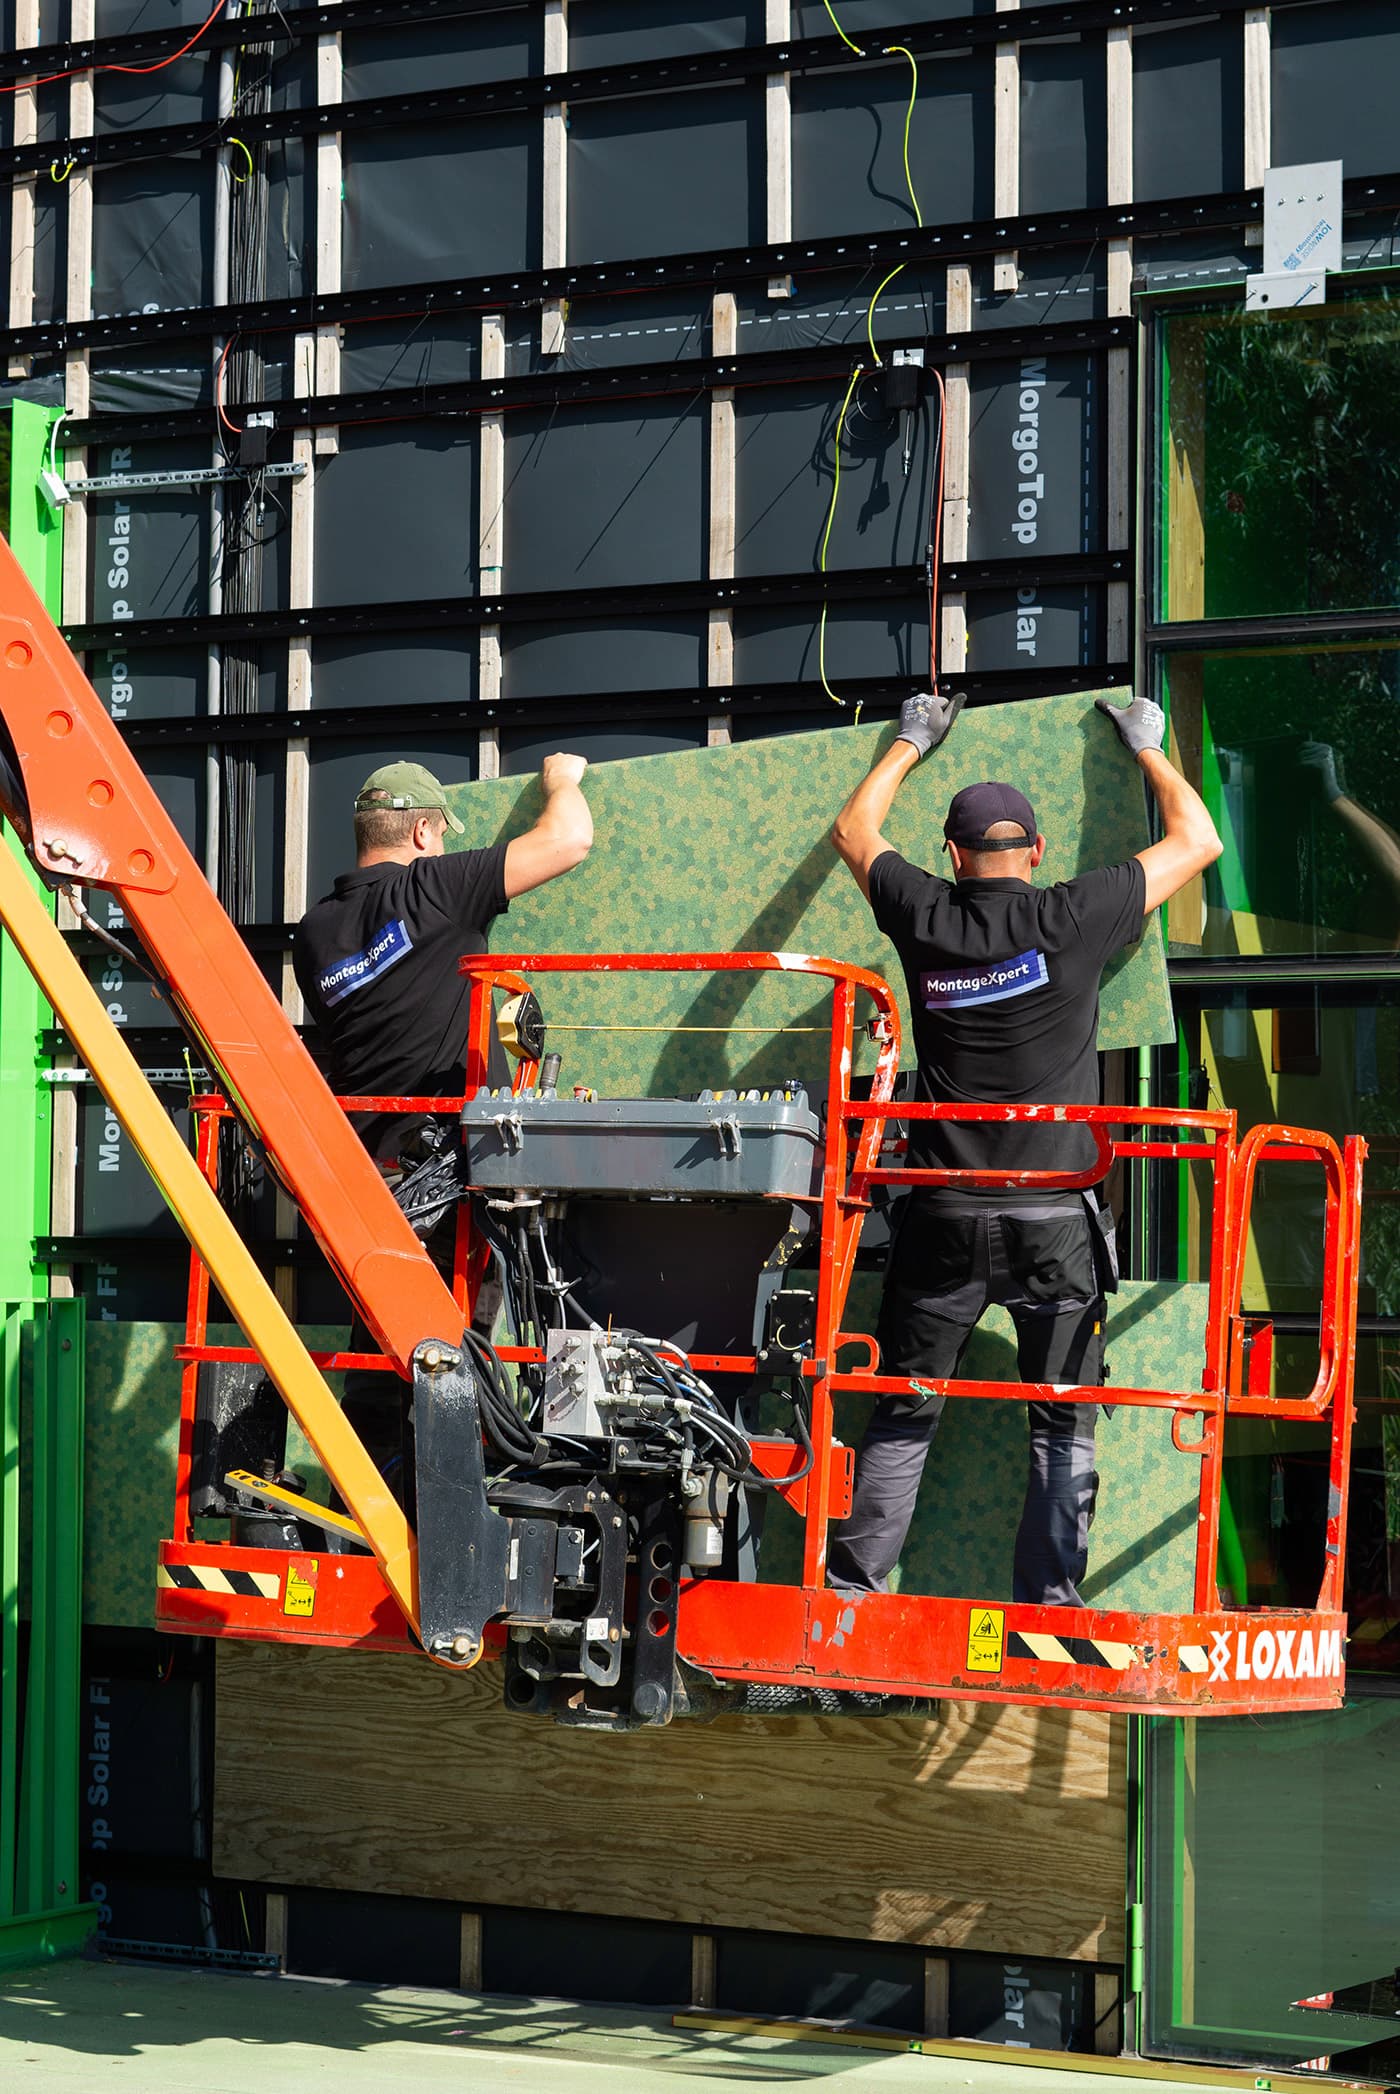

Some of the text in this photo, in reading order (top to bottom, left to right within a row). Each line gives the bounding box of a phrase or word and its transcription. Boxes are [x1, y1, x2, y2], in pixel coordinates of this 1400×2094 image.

[1012, 357, 1047, 657] MorgoTop olar
[107, 500, 131, 589] Solar
[320, 933, 396, 992] MontageXpert
[927, 963, 1030, 993] MontageXpert
[1235, 1630, 1341, 1680] LOXAM
[87, 1716, 111, 1807] Solar
